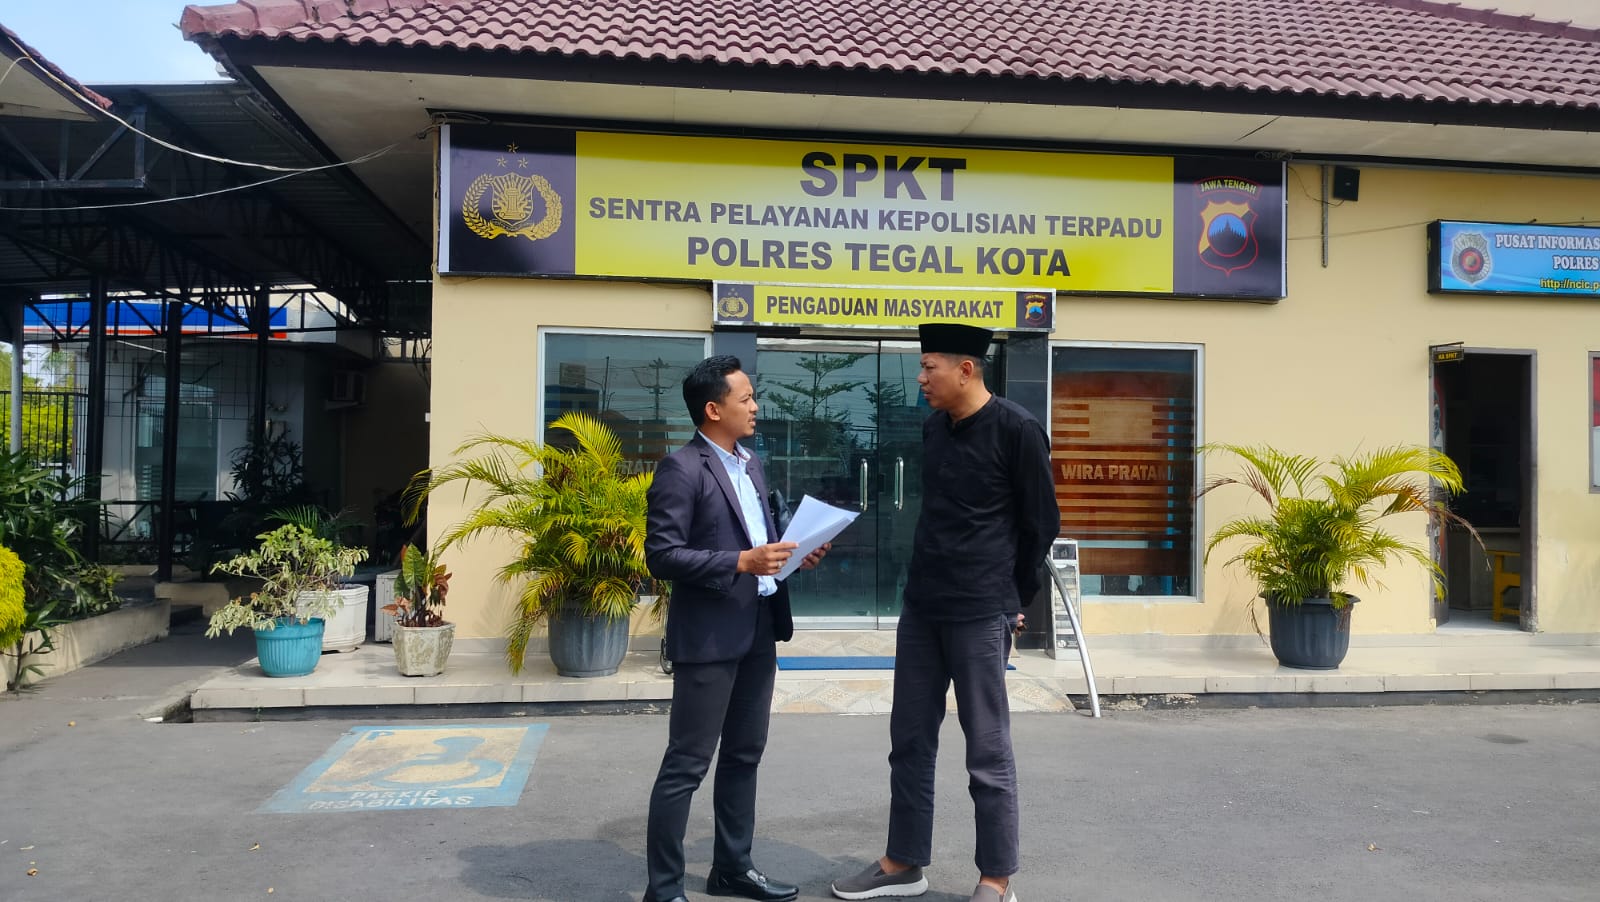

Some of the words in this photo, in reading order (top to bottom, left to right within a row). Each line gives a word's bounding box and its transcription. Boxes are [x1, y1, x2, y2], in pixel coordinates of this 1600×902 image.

[800, 151, 967, 201] SPKT
[1201, 179, 1222, 192] JAWA
[1223, 179, 1257, 195] TENGAH
[589, 197, 701, 222] SENTRA
[710, 202, 868, 230] PELAYANAN
[878, 209, 1036, 235] KEPOLISIAN
[1045, 215, 1162, 239] TERPADU
[1495, 233, 1536, 248] PUSAT
[1538, 235, 1600, 250] INFORMAS
[687, 236, 833, 270] POLRES
[844, 242, 964, 274] TEGAL
[976, 246, 1071, 277] KOTA
[1553, 255, 1599, 270] POLRES
[1541, 279, 1600, 291] http://ncic.p
[766, 295, 880, 316] PENGADUAN
[884, 298, 1004, 318] MASYARAKAT
[1061, 464, 1104, 480] WIRA
[351, 789, 438, 799] PARKIR
[308, 796, 475, 810] DISABILITAS
